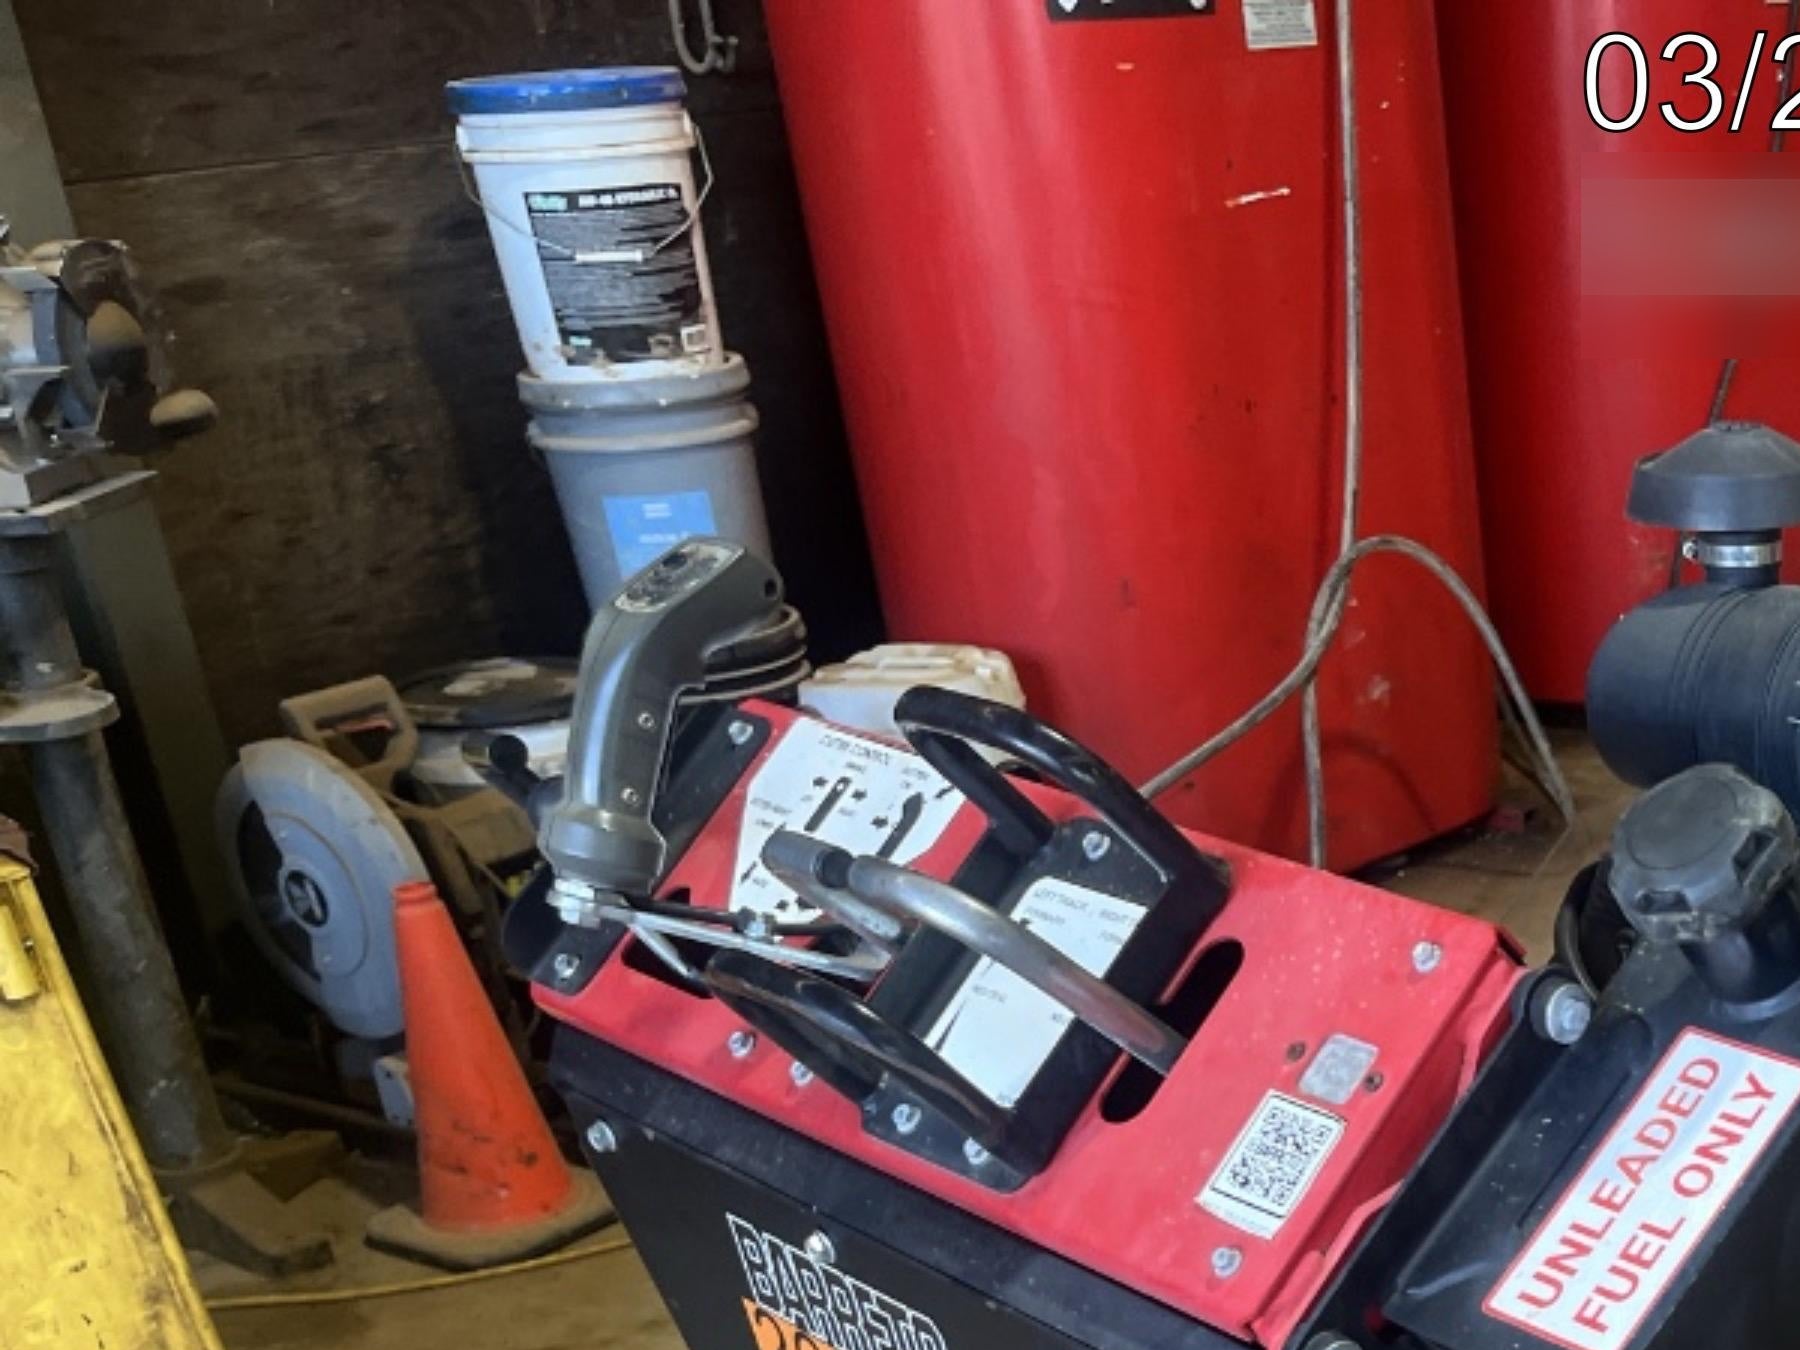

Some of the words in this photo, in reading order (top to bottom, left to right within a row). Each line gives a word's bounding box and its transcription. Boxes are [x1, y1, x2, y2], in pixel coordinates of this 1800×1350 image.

[1517, 1057, 1720, 1309] UNLEADED
[1572, 1215, 1685, 1333] FUEL
[1673, 1071, 1777, 1198] ONLY
